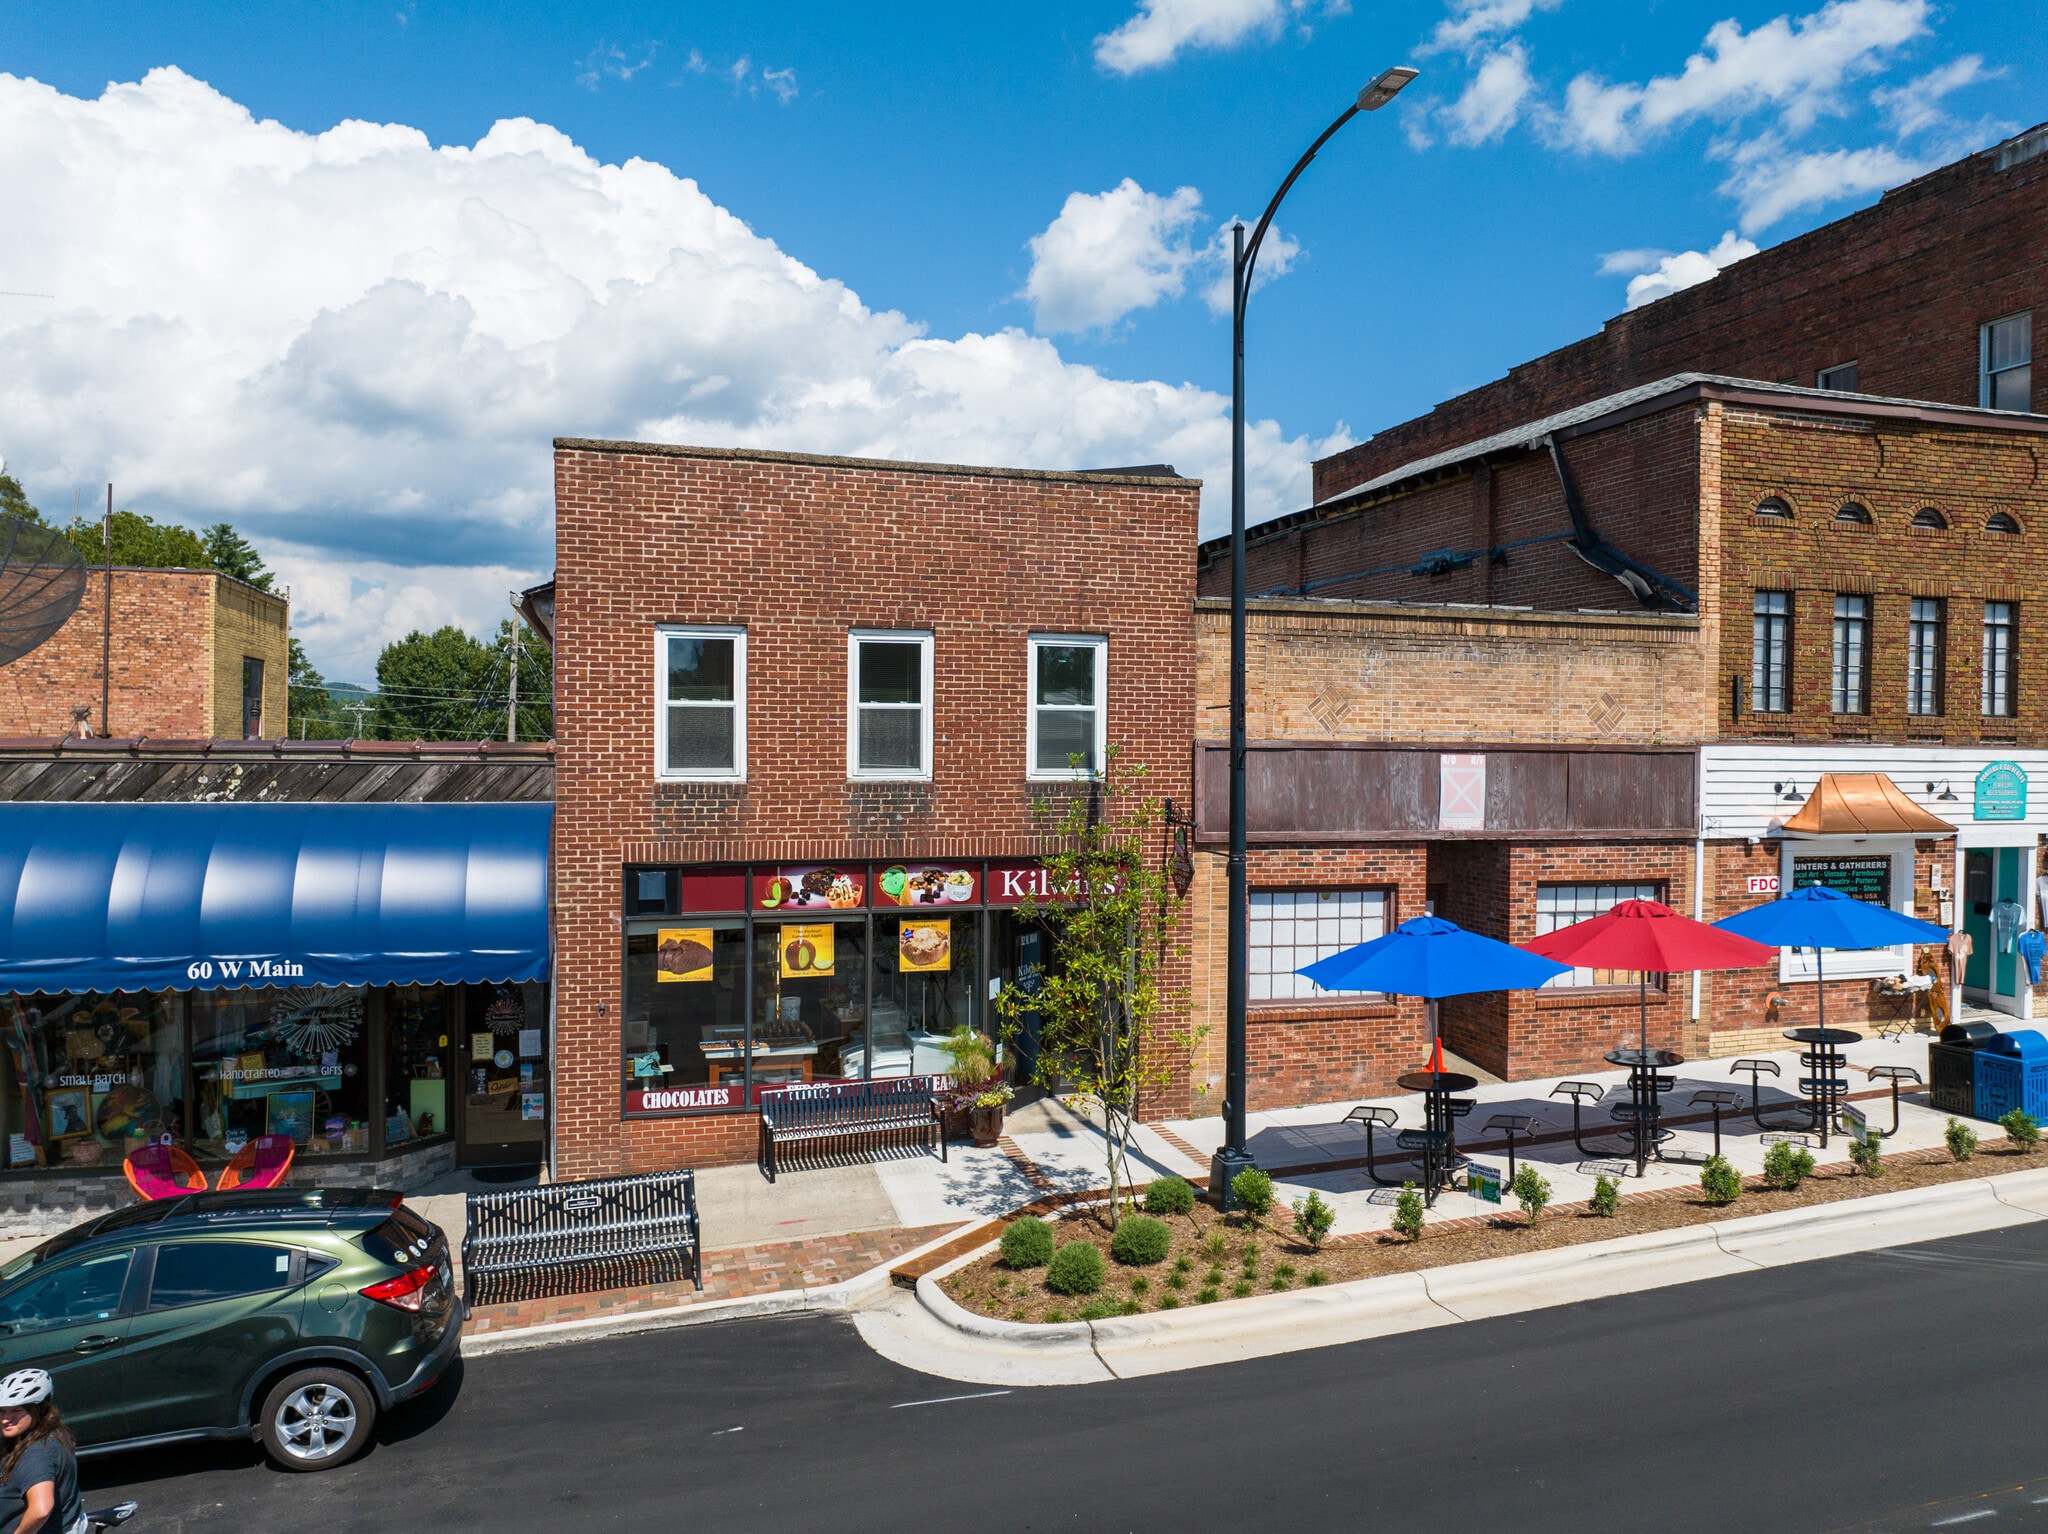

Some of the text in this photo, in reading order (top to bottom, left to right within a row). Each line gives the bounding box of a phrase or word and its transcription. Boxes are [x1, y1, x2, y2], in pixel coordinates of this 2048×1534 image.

[1830, 862, 1837, 870] &
[1839, 861, 1887, 870] GATHERERS
[1793, 871, 1807, 879] ocal
[1851, 869, 1884, 877] Farmhouse
[1750, 877, 1779, 891] FDC
[1827, 878, 1851, 886] Jewelry
[1855, 877, 1878, 885] Pottery
[187, 959, 304, 980] 60 W Main
[321, 1065, 343, 1076] GIFTS
[642, 1088, 729, 1110] CHOCOLATES
